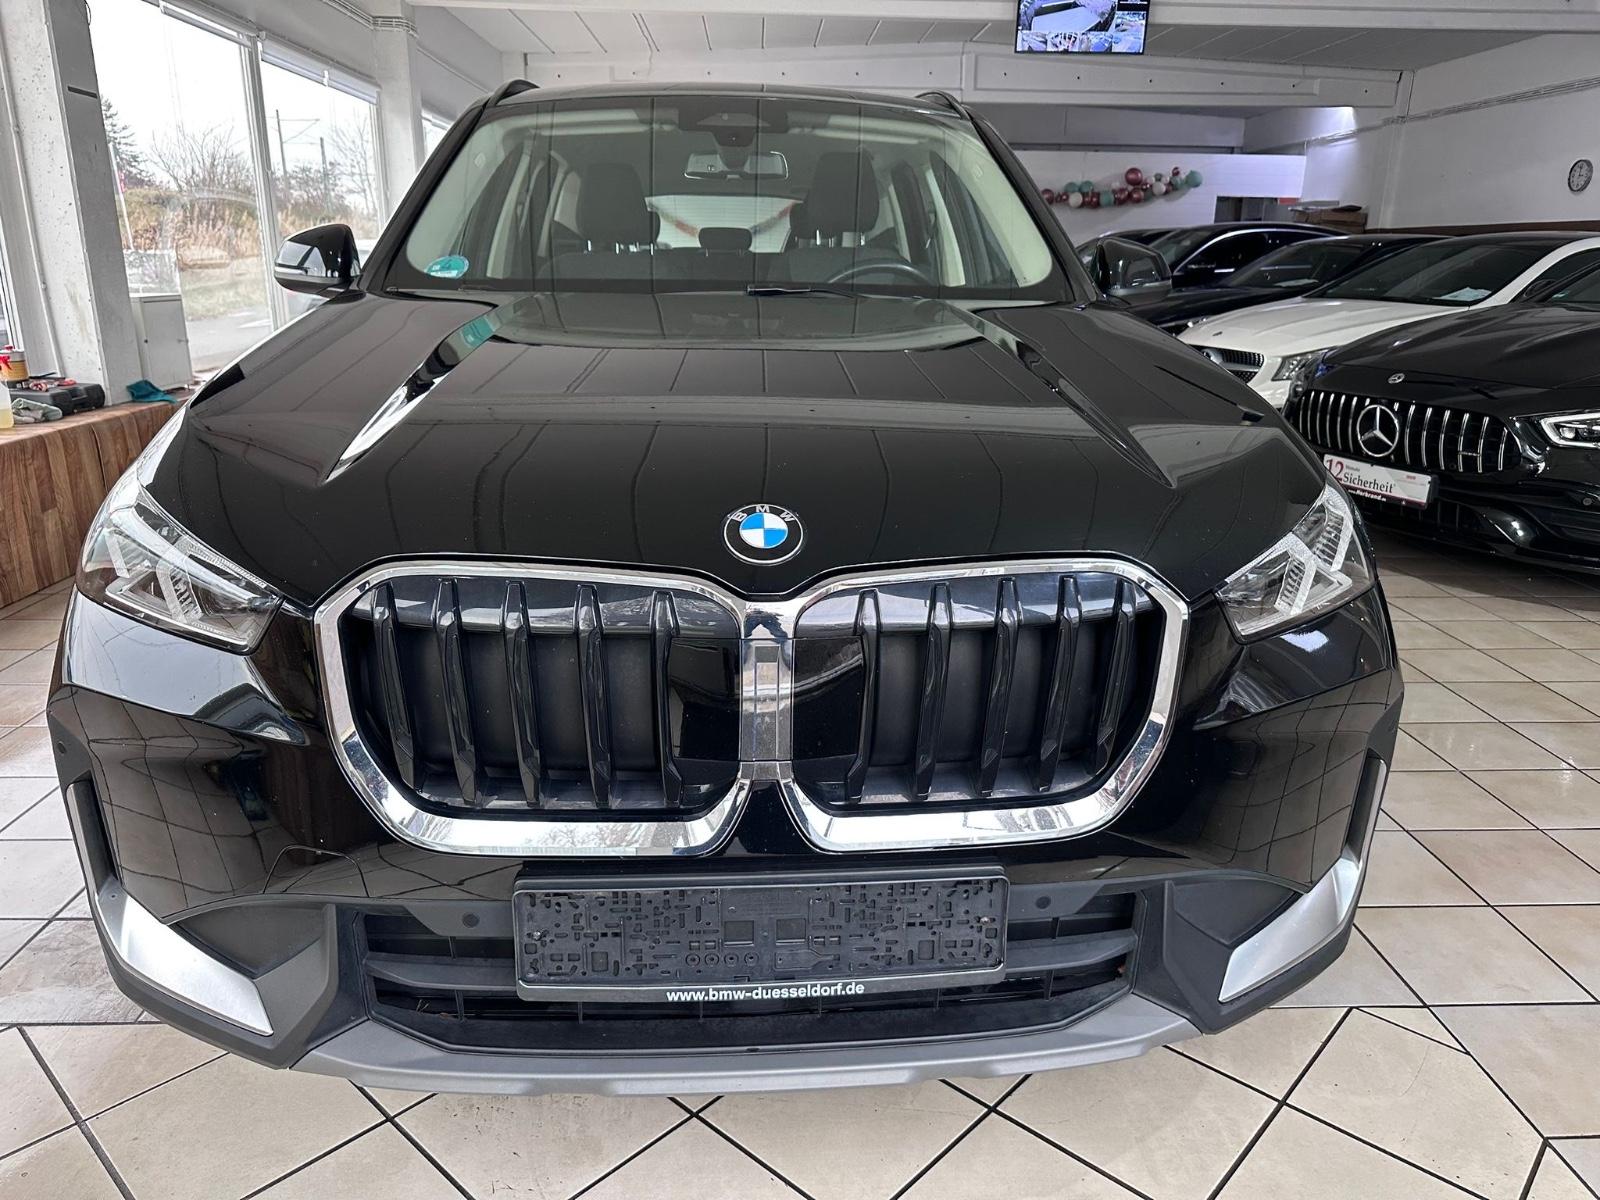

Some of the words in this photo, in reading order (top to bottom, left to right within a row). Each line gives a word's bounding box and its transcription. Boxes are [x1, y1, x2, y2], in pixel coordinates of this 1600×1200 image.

[1326, 458, 1344, 482] 12
[1343, 472, 1394, 493] Sicherheit
[731, 504, 796, 522] BMW
[666, 982, 865, 1001] www.bmw-duesseldorf.de
